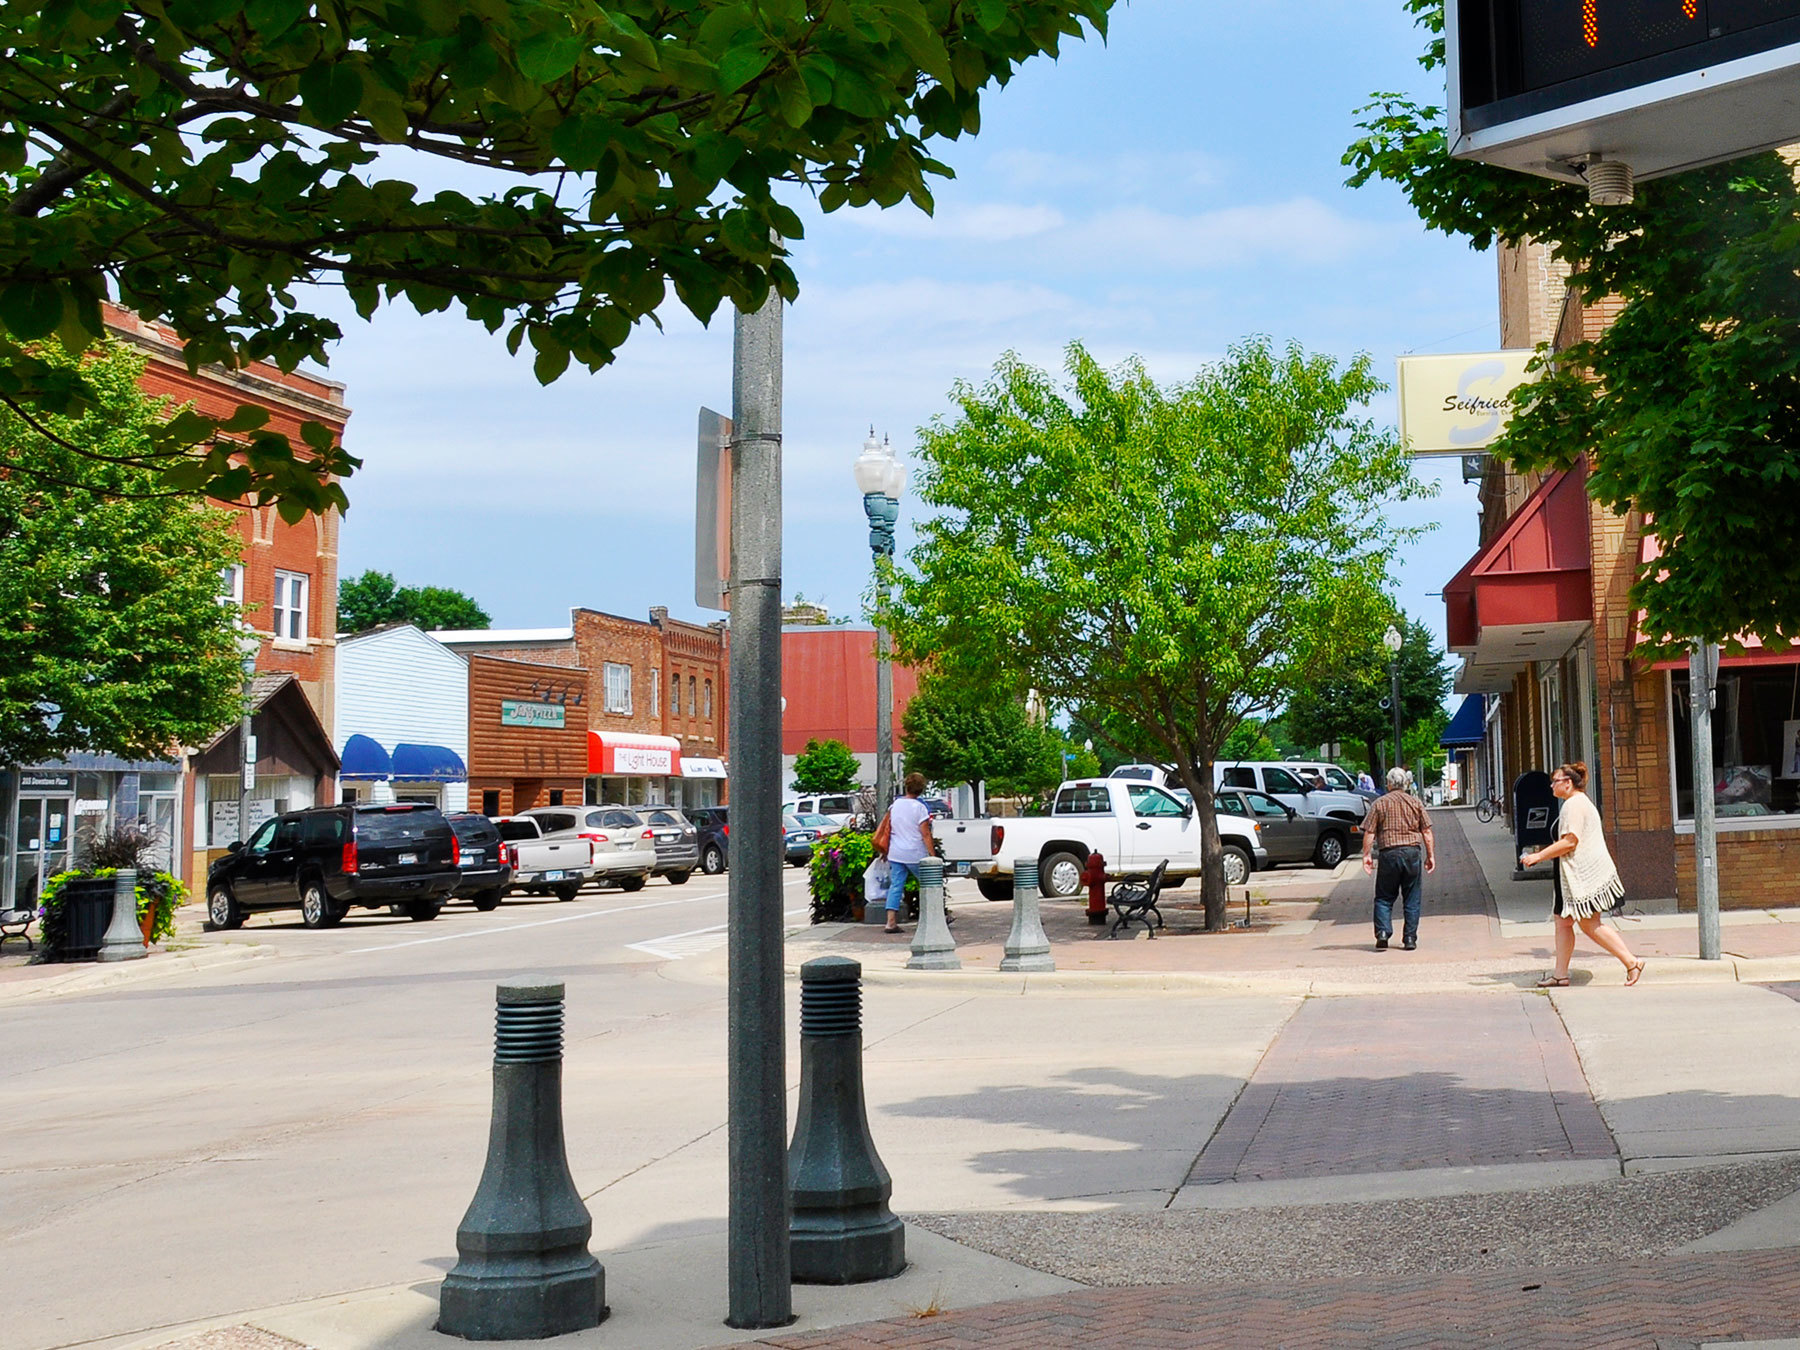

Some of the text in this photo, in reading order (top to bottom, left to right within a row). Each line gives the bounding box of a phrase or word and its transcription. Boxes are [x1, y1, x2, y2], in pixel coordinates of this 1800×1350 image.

[628, 751, 645, 770] Light
[646, 752, 668, 768] House
[55, 777, 68, 786] Plaza
